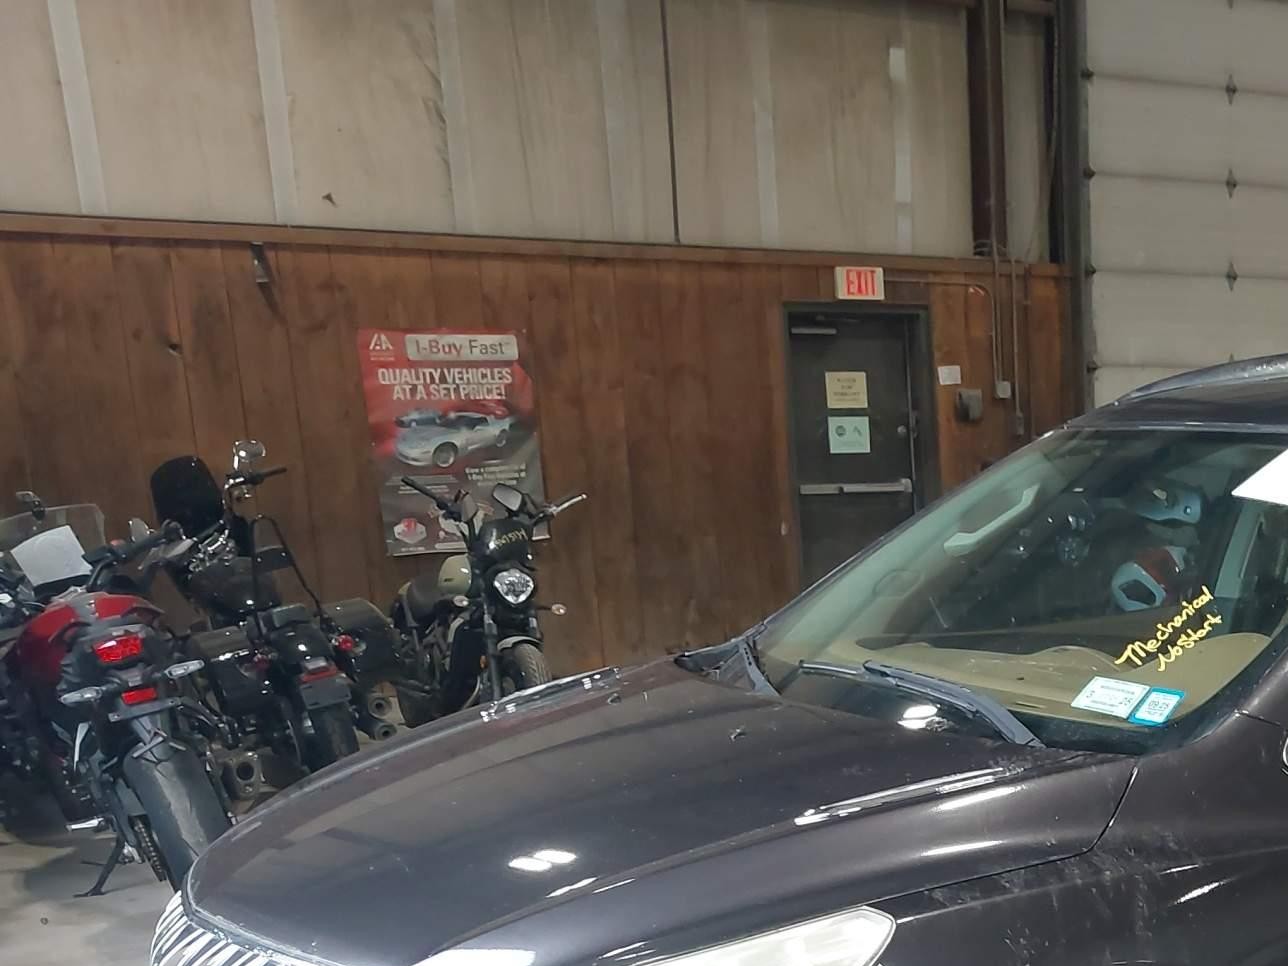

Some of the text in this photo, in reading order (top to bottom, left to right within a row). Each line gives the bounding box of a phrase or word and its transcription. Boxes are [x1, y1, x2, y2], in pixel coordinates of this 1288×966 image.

[845, 269, 876, 296] EXIT
[415, 340, 463, 357] I-Buy
[468, 339, 505, 355] Fast
[378, 368, 513, 384] QUALITY VEHICLES
[392, 384, 506, 400] AT A SET PRICE!
[1114, 585, 1214, 666] Mechanical
